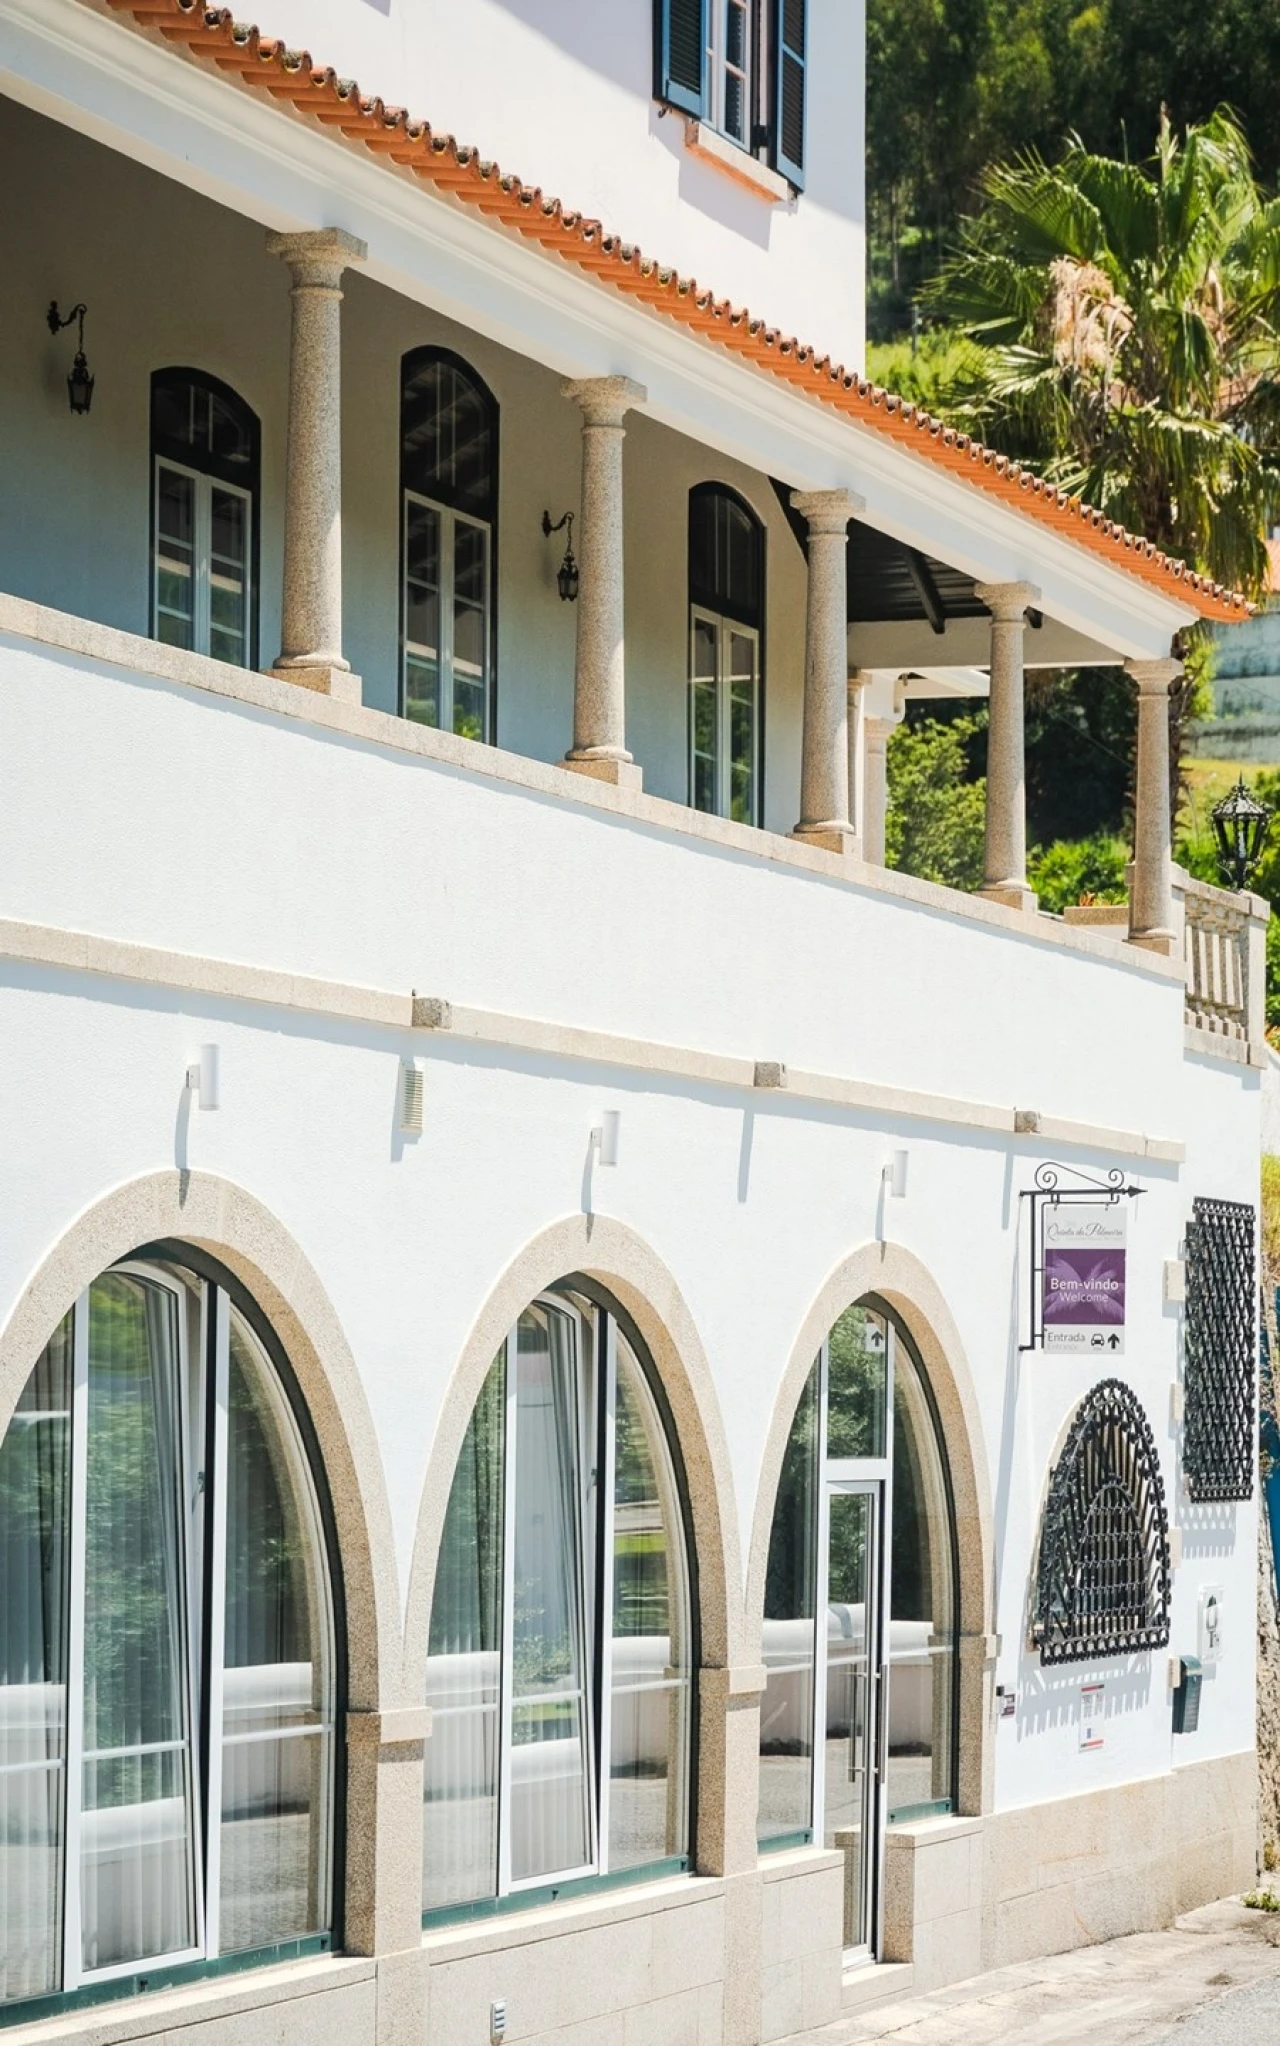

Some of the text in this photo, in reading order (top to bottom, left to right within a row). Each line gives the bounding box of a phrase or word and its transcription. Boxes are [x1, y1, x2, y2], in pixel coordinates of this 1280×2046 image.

[1050, 1278, 1119, 1291] Bem-vindo
[1059, 1292, 1109, 1302] Welcome
[1047, 1332, 1086, 1342] Entrada
